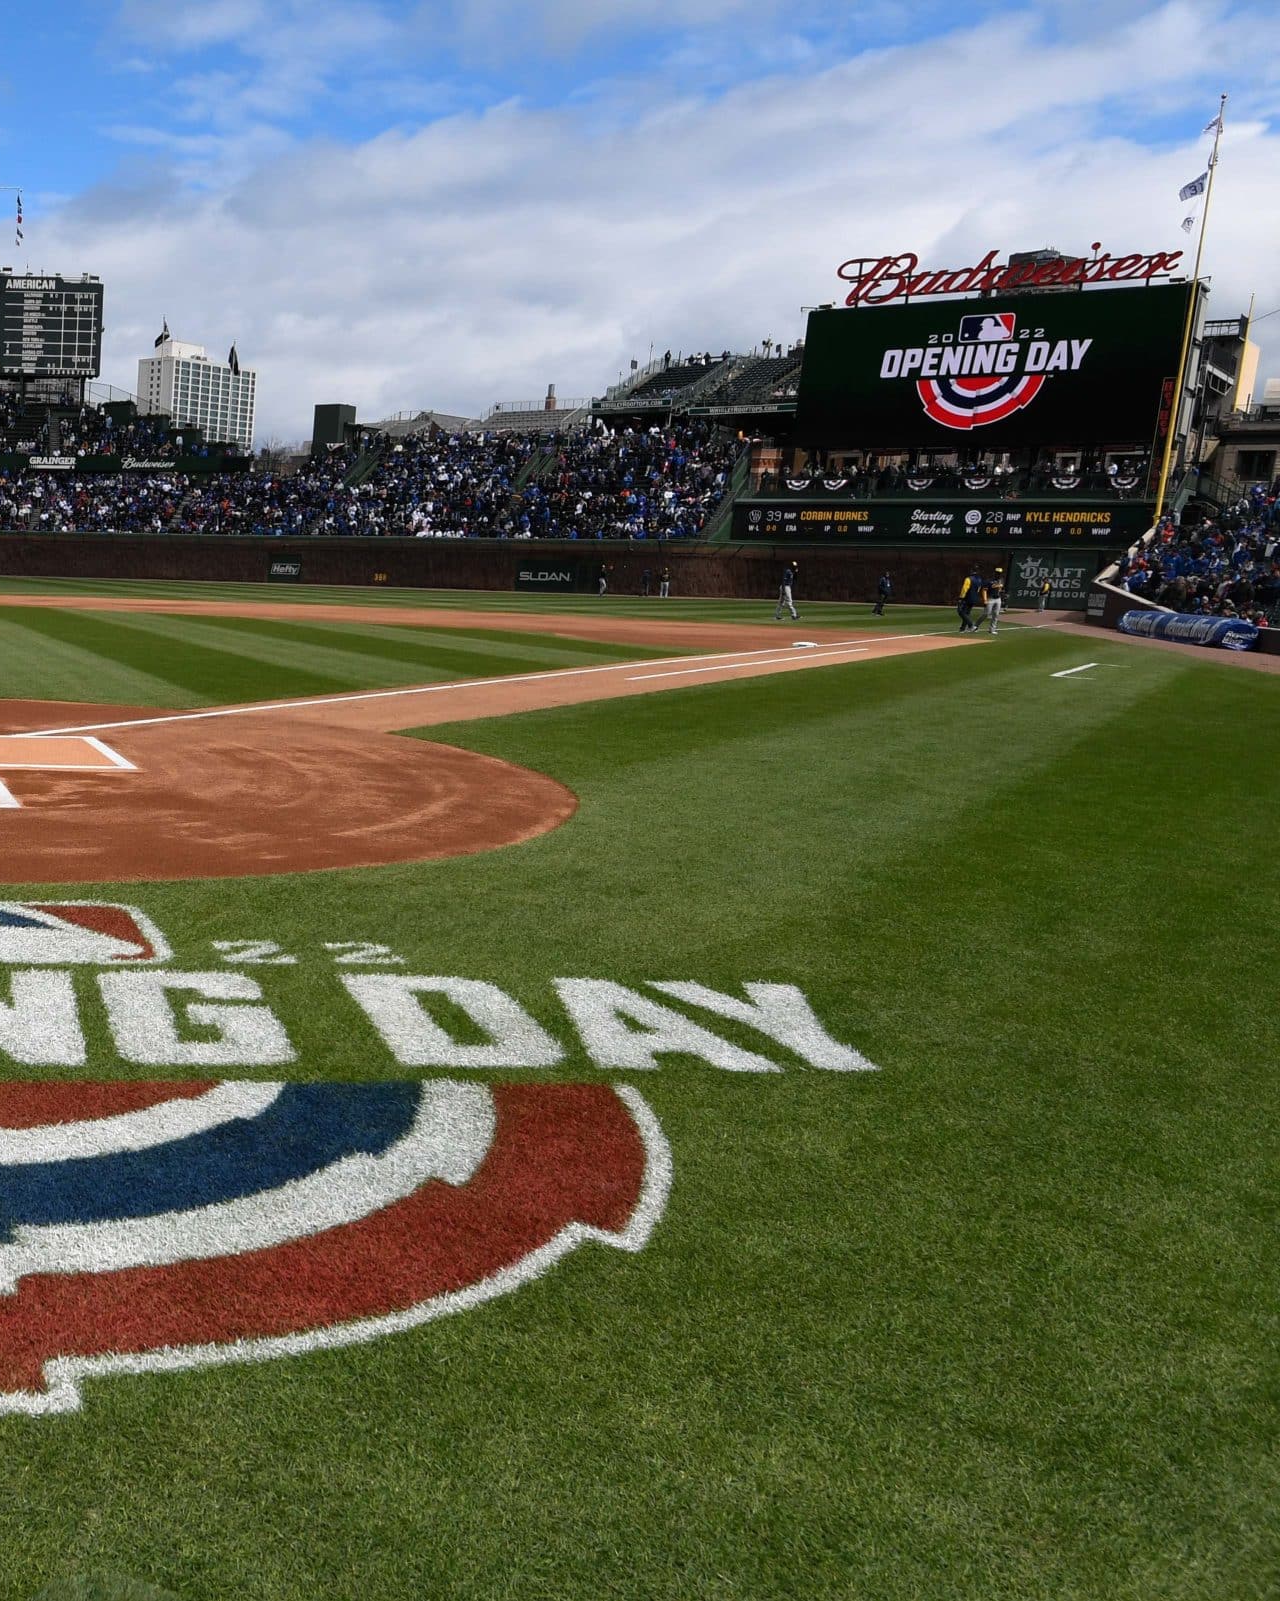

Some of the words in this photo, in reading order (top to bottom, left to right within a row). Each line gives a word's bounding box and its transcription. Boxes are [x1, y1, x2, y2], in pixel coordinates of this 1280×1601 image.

[837, 242, 1183, 306] Budweiser
[6, 279, 56, 290] AMERICAN
[928, 334, 953, 344] 20
[1019, 328, 1046, 339] 22
[880, 342, 1020, 379] OPENING
[1024, 338, 1093, 372] DAY
[29, 456, 76, 465] GRAINGER
[120, 457, 176, 469] Budweiser
[766, 511, 782, 522] 39
[800, 511, 832, 520] CORBIN
[834, 511, 868, 521] BURNES
[911, 509, 954, 525] Starting
[985, 511, 1003, 523] 28
[1025, 512, 1052, 522] KYLE
[1052, 512, 1111, 523] HENDRICKS
[908, 523, 951, 534] Pitchers
[966, 526, 978, 534] W-L
[1054, 527, 1062, 535] IP
[1070, 527, 1082, 535] 0.0
[1091, 527, 1111, 535] WHIP
[272, 563, 298, 575] Hefty
[1020, 567, 1086, 579] DRAFT
[519, 571, 570, 582] SLOAN
[1026, 577, 1081, 589] KNGS
[1017, 590, 1086, 598] SPOSBOOK
[212, 941, 406, 964] 22
[341, 972, 880, 1074] DAY
